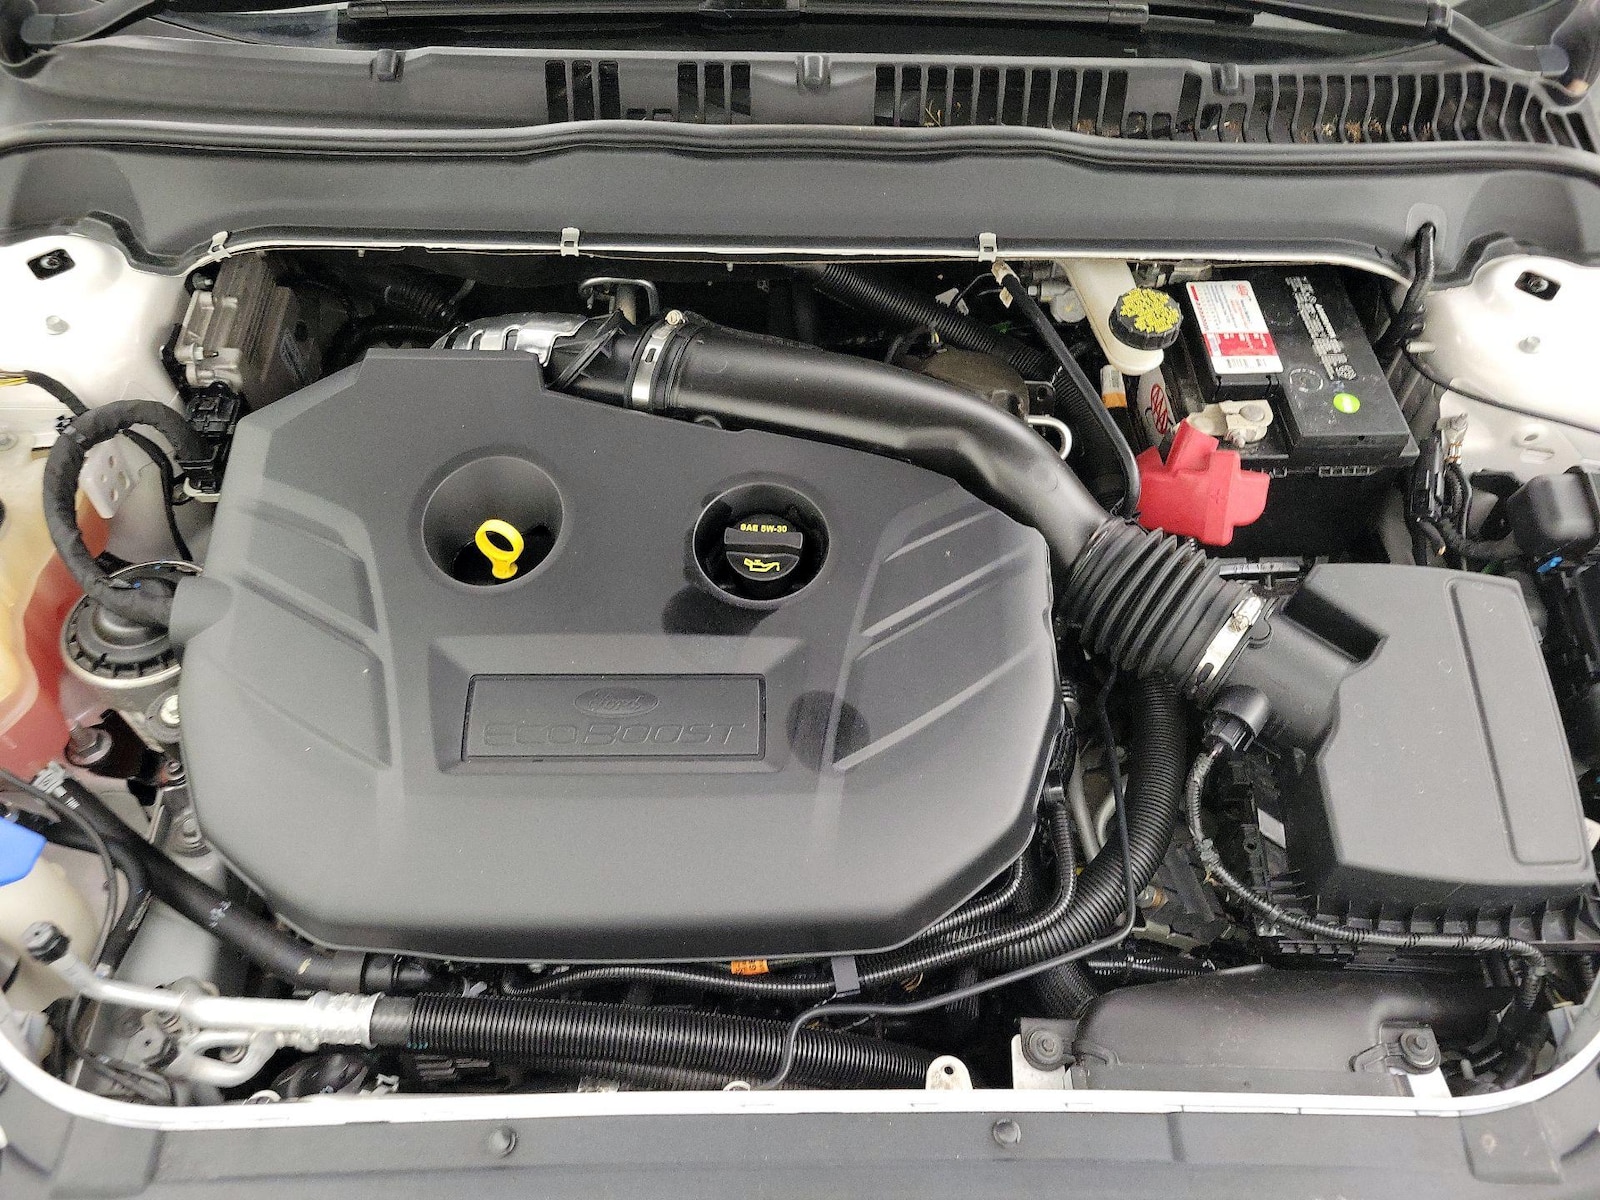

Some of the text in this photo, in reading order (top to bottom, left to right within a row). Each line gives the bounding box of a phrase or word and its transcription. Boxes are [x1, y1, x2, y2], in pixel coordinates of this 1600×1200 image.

[740, 523, 788, 533] SAE 5W-30
[587, 690, 646, 712] Ford
[483, 722, 747, 746] ECOBOOST
